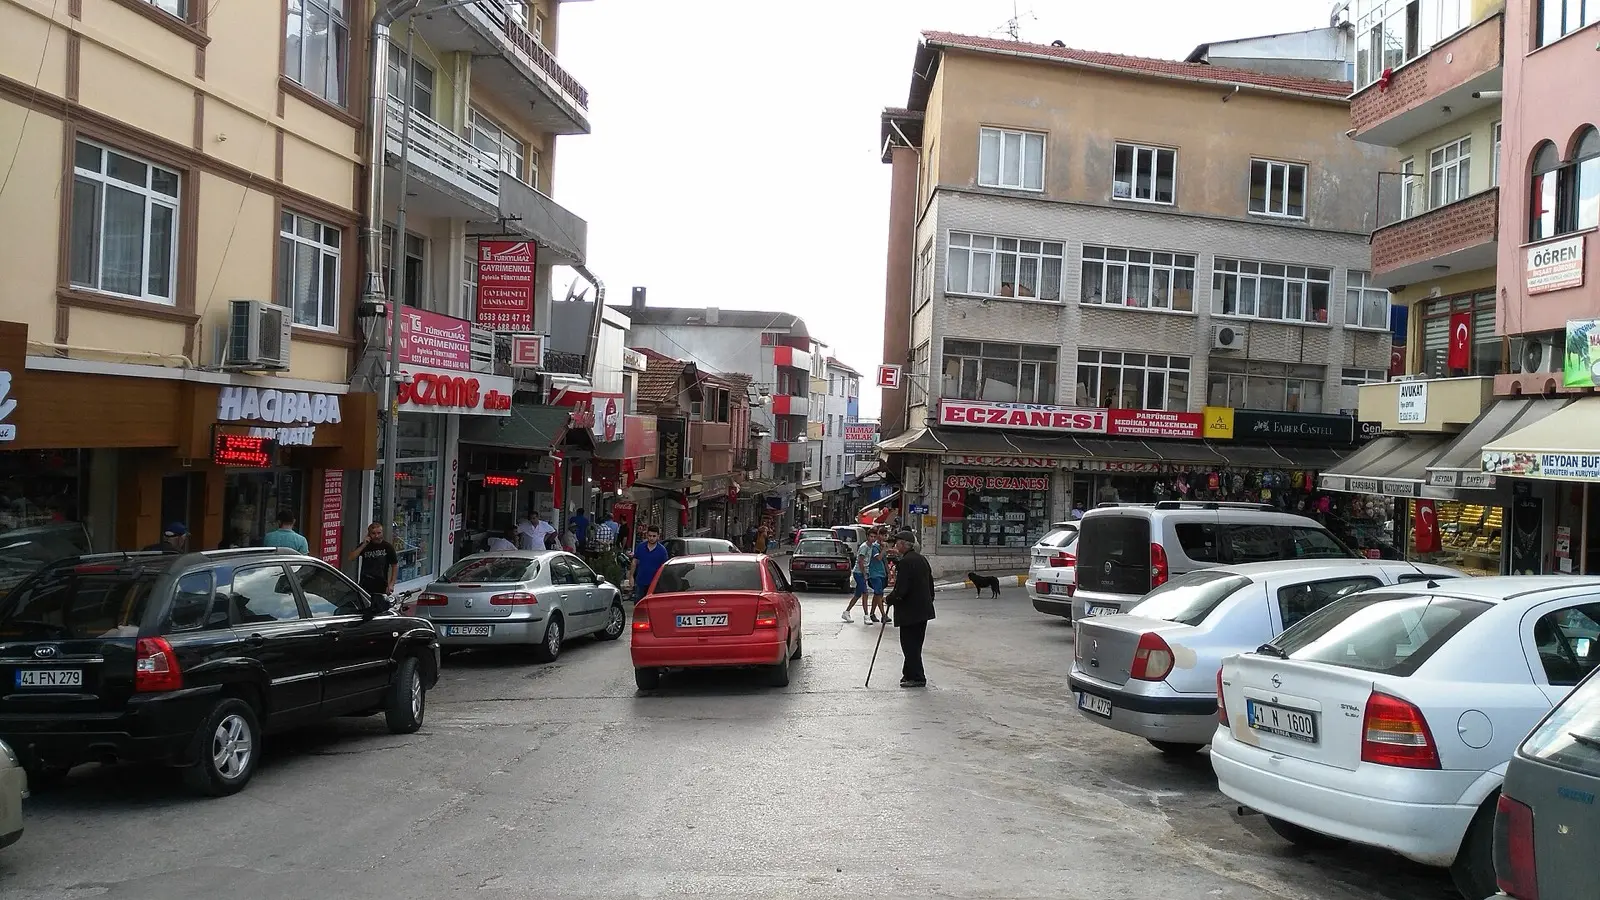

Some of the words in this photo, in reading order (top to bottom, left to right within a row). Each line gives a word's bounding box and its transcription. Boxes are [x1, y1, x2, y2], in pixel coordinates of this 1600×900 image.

[1533, 245, 1577, 267] ÖĞREN
[481, 264, 532, 273] GAYRİMENKUL
[480, 313, 496, 321] 0533
[497, 313, 510, 321] 623
[512, 314, 520, 322] 47
[523, 314, 531, 322] 12
[425, 326, 466, 340] TÜRKYILMAZ
[411, 335, 470, 352] GAYRİMENKUL
[882, 368, 895, 386] E
[1401, 384, 1424, 397] AVUKAT
[217, 386, 342, 424] HACIBABA
[945, 407, 1104, 430] ECZANESİ
[1136, 412, 1178, 421] PARFÜMERİ
[1115, 419, 1147, 427] MEDİKAL
[1149, 420, 1198, 429] MALZEMELER
[1118, 426, 1159, 434] VETERİNER
[1161, 426, 1194, 436] İLAÇLARI
[1541, 454, 1579, 468] MEYDAN
[1581, 455, 1600, 468] BUF
[946, 474, 984, 492] GENÇ
[986, 474, 1050, 491] ECZANESİ
[681, 616, 692, 626] 41
[695, 616, 706, 625] ET
[711, 615, 727, 625] 727
[451, 626, 460, 635] 41
[462, 625, 472, 635] EV
[474, 626, 488, 635] 999
[22, 671, 35, 685] 41
[39, 671, 56, 685] FN
[59, 671, 80, 685] 279
[1254, 705, 1264, 723] 41
[1271, 709, 1279, 727] N
[1287, 713, 1312, 734] 1600
